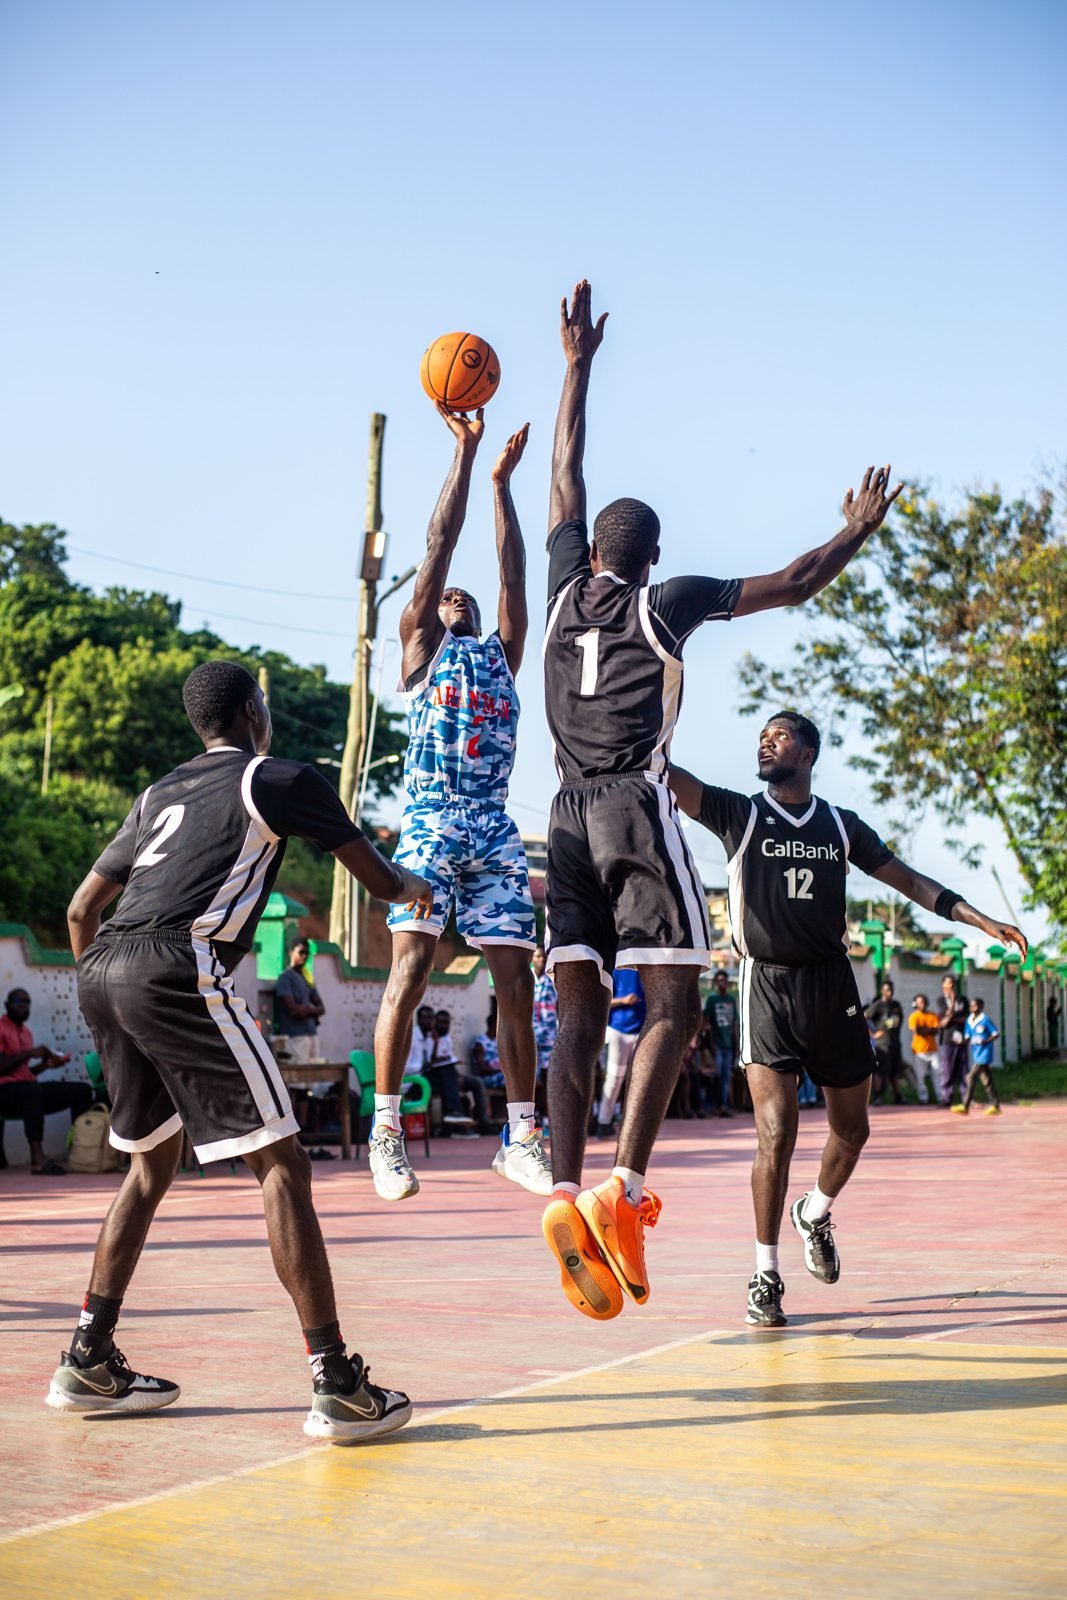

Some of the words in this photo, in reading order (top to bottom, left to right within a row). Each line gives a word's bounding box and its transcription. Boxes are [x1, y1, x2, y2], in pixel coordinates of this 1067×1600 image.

[574, 627, 600, 696] 1
[133, 804, 185, 868] 2
[761, 838, 839, 862] CalBank
[783, 867, 814, 900] 12
